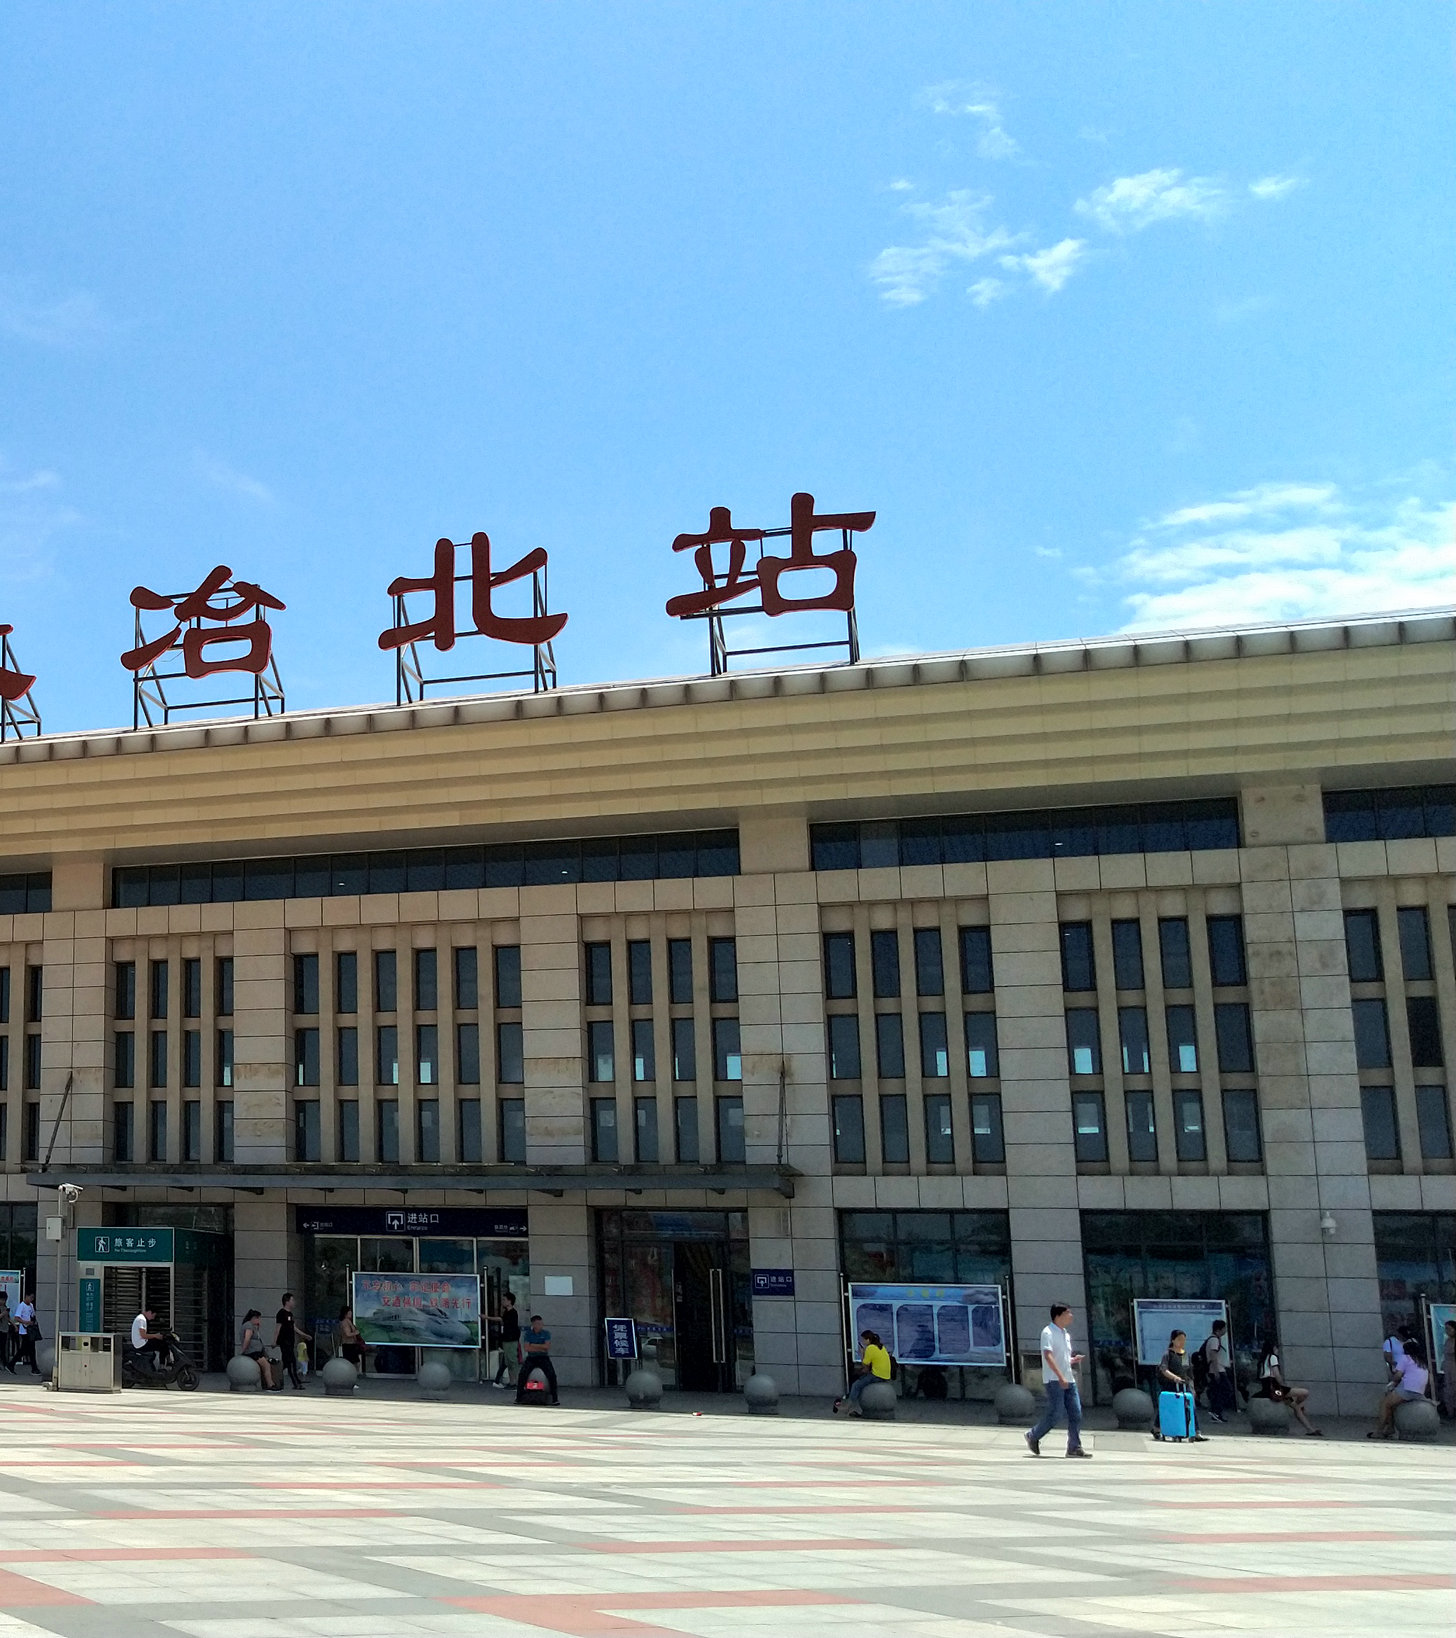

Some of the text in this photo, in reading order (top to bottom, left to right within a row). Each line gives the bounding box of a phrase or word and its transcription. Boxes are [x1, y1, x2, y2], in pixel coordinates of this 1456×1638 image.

[407, 1212, 440, 1224] 进站口
[114, 1237, 157, 1248] 旅客止步
[770, 1275, 793, 1283] 进站口
[612, 1323, 630, 1355] 凭票候车
